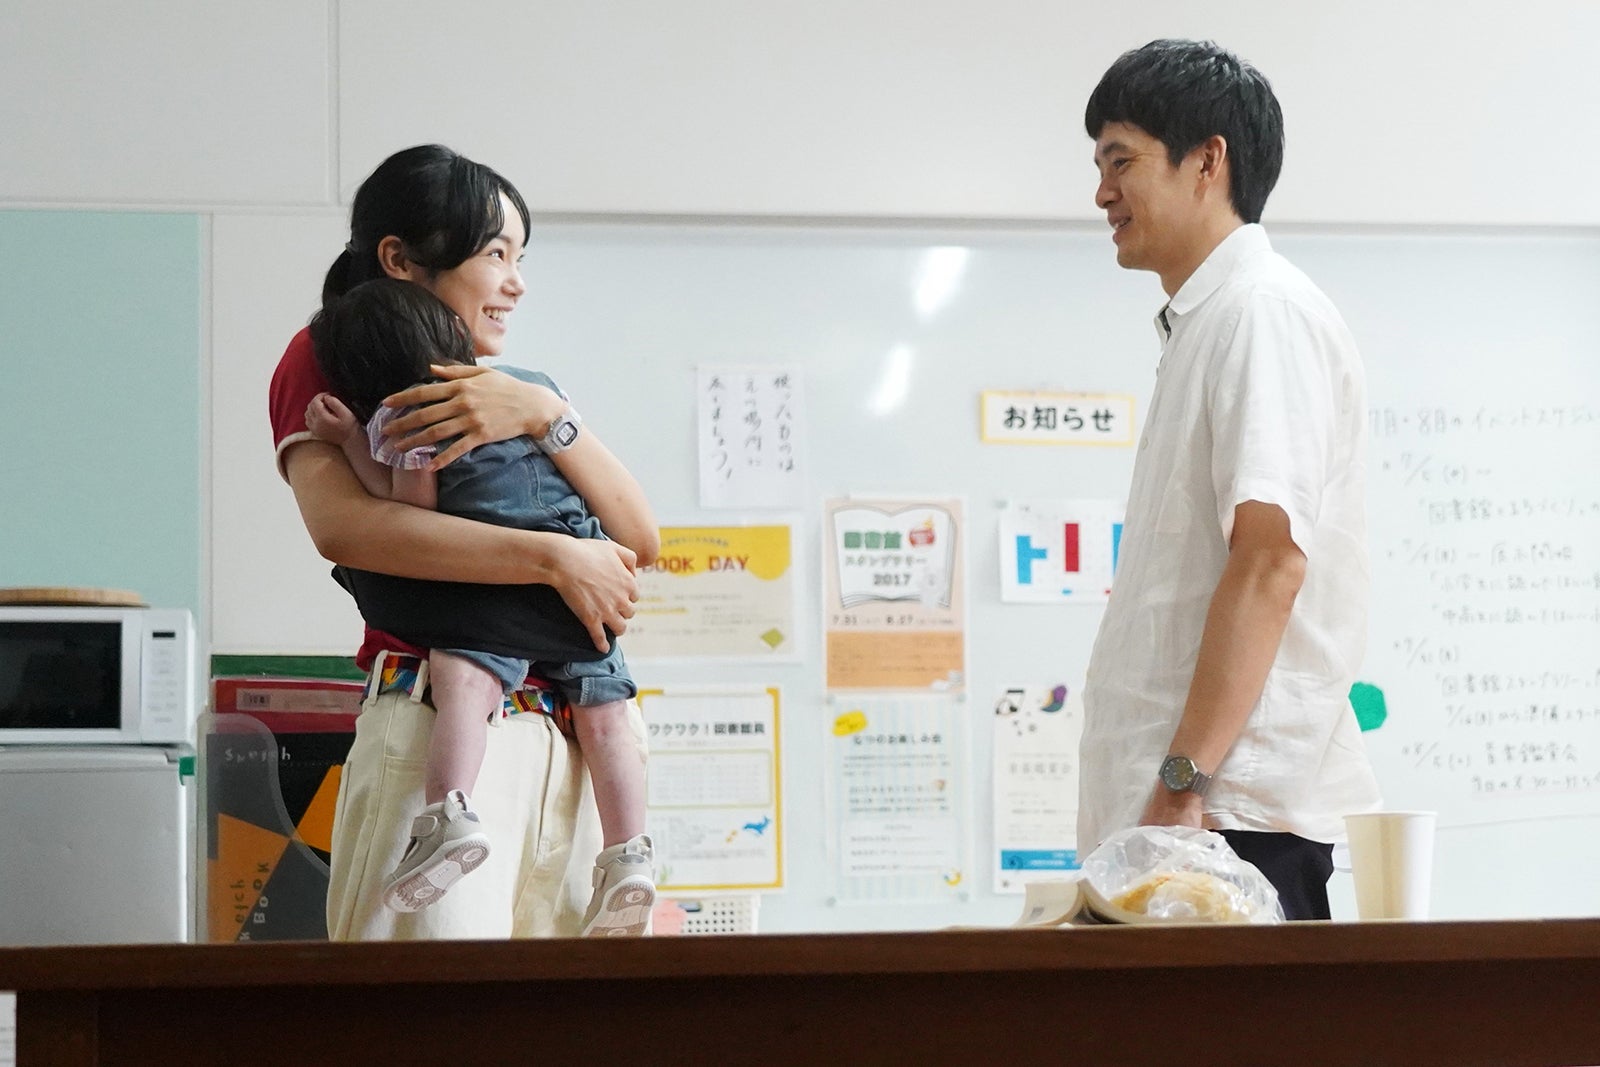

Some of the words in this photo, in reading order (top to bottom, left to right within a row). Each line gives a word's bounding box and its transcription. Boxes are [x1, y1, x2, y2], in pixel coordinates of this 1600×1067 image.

[1003, 405, 1115, 432] お知らせ
[708, 555, 750, 572] DAY
[873, 573, 911, 586] 2017
